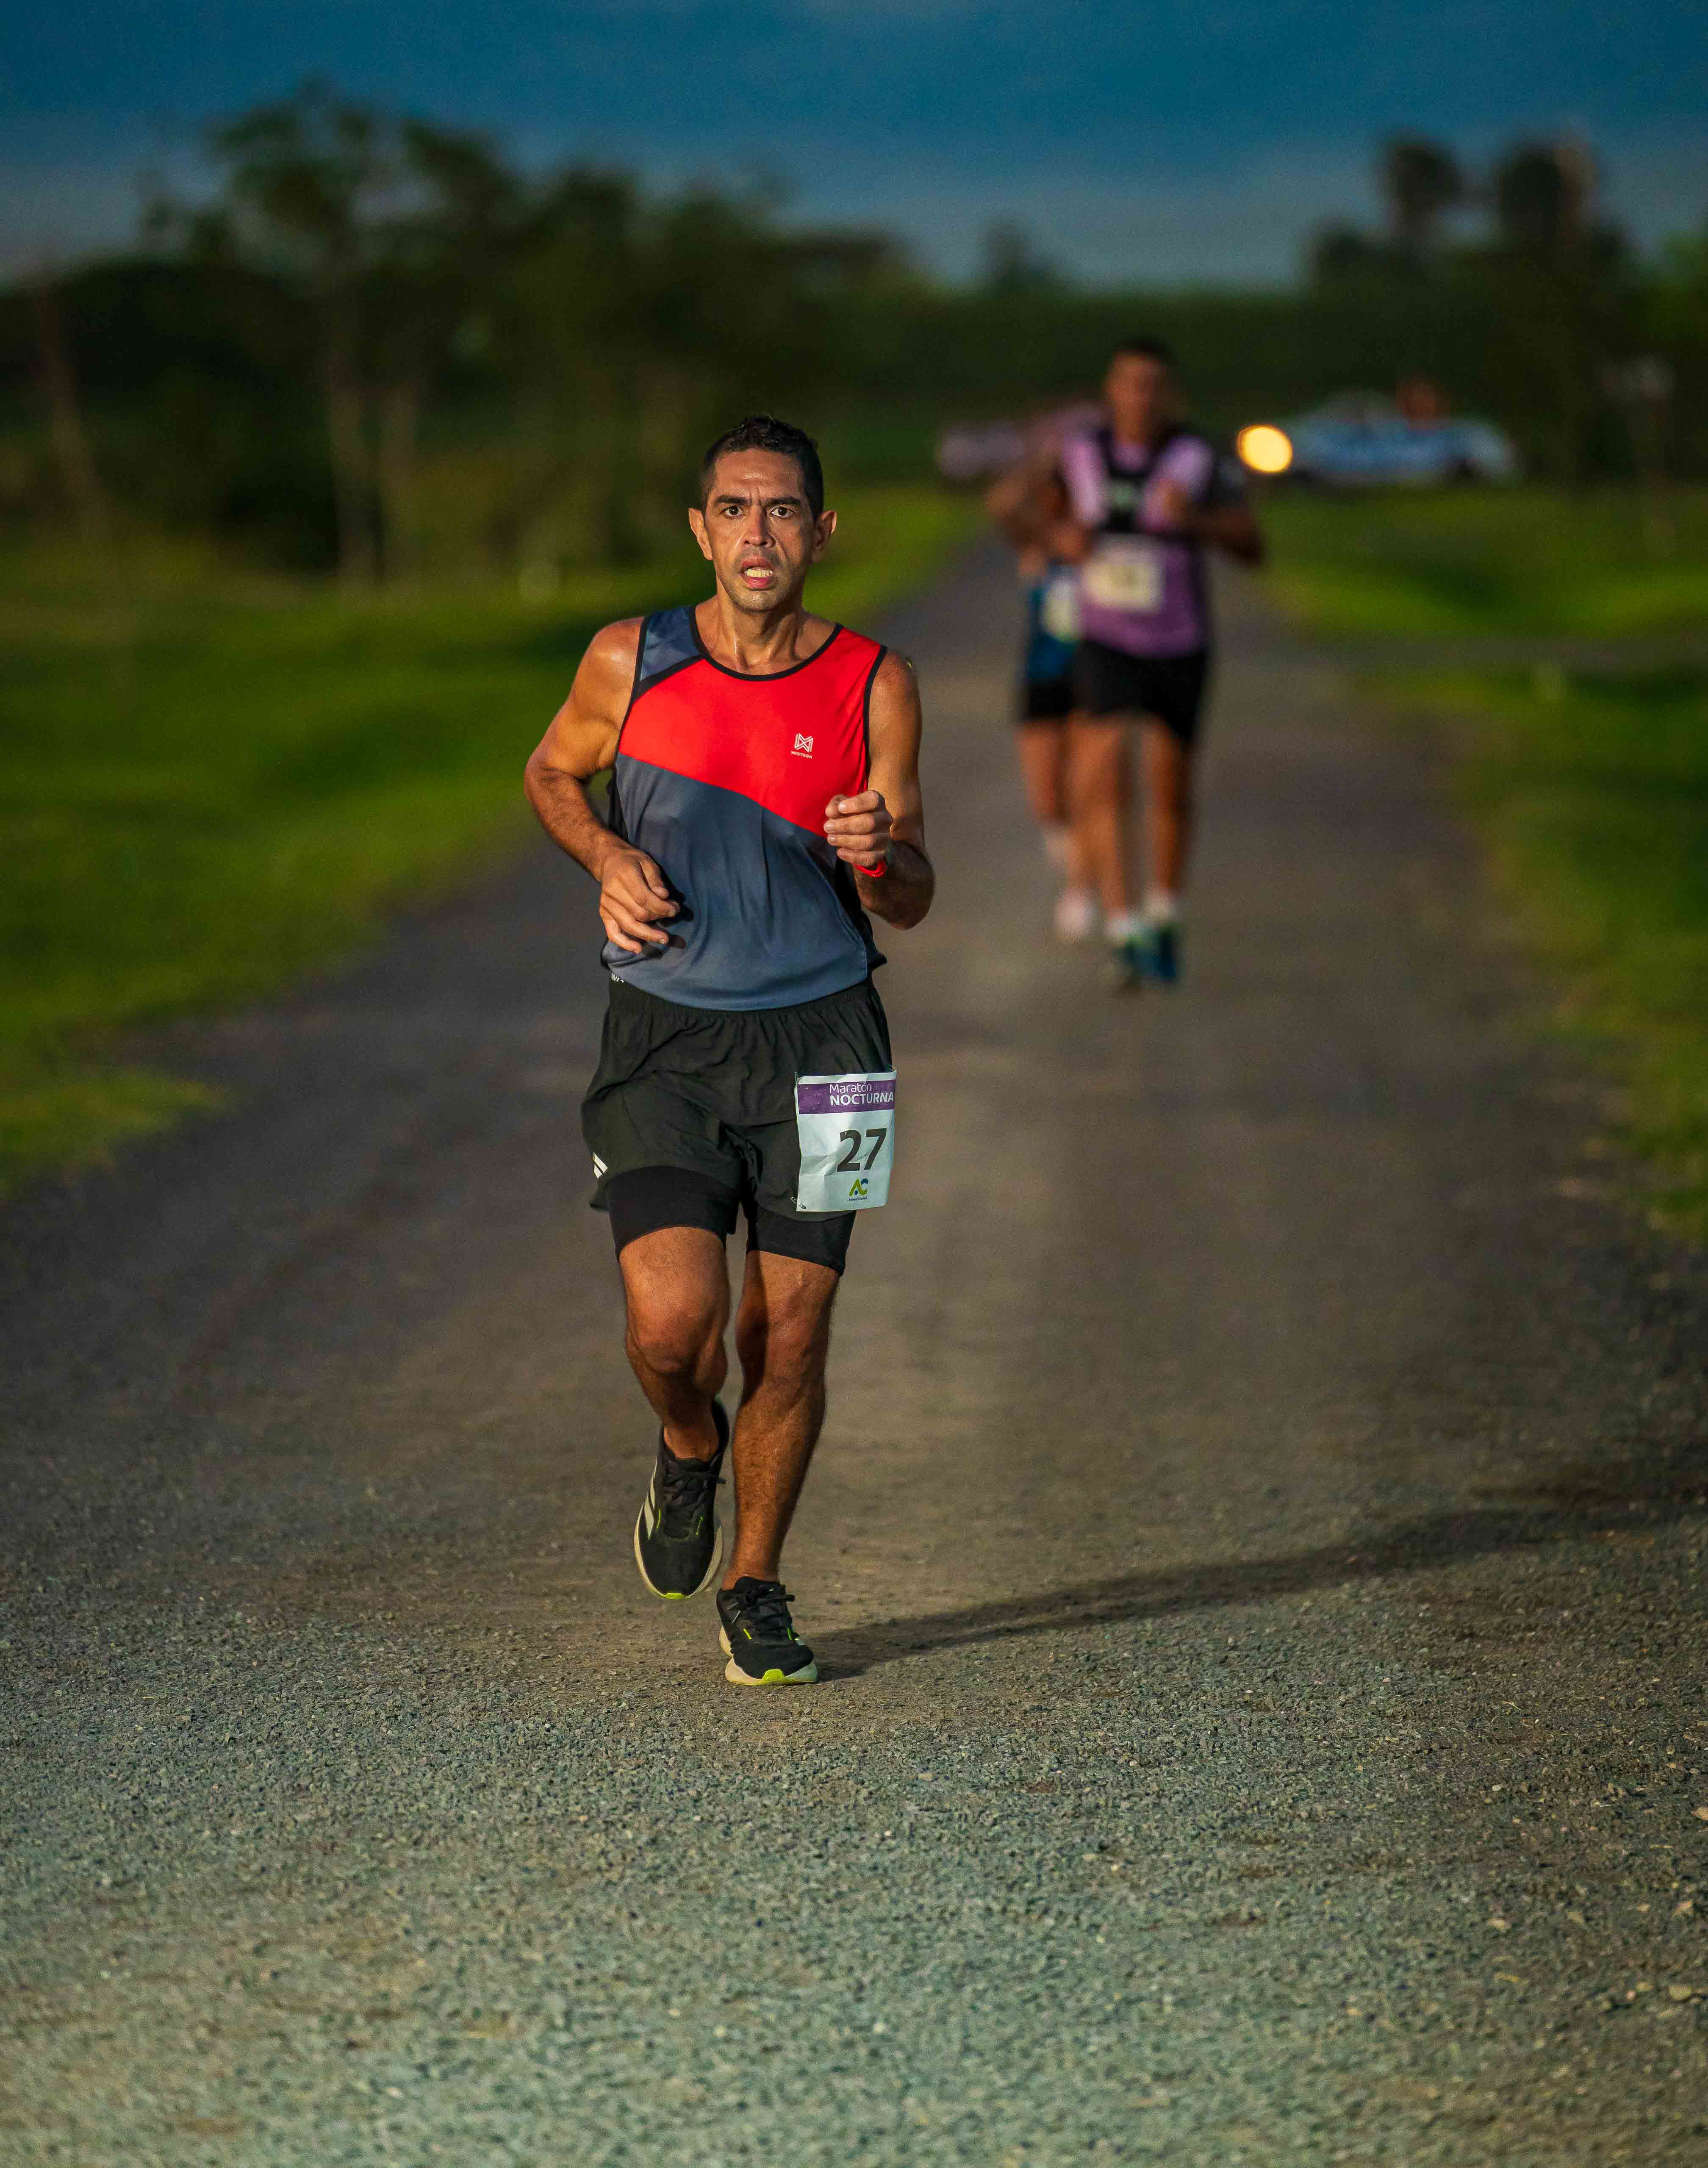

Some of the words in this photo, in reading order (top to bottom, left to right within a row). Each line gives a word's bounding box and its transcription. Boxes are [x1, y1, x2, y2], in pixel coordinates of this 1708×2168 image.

[829, 1081, 871, 1093] Maratón
[830, 1092, 894, 1106] NOCTURNA
[837, 1128, 887, 1172] 27
